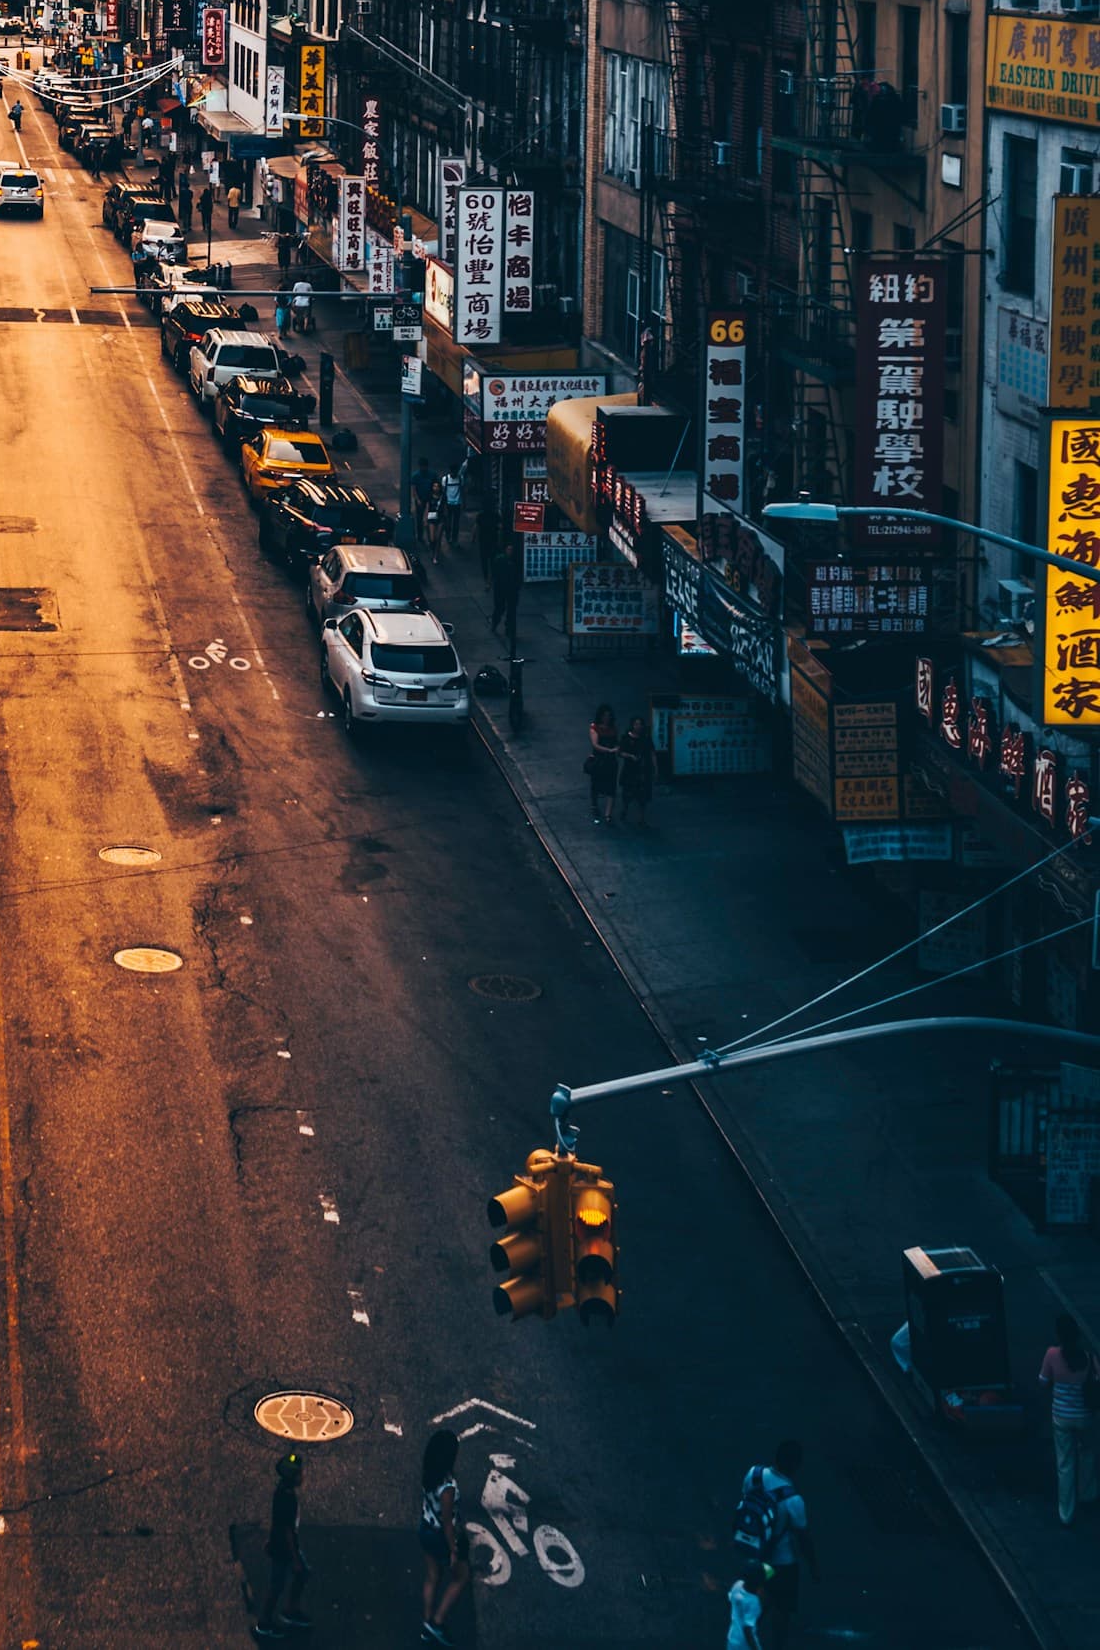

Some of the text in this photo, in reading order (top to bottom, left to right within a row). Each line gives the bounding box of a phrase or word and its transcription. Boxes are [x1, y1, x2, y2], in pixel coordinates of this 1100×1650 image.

[999, 63, 1056, 91] EASTERN
[465, 194, 495, 209] 60
[868, 273, 935, 303] 紐約
[710, 319, 745, 343] 66
[873, 317, 926, 499] 第一駕駛學校
